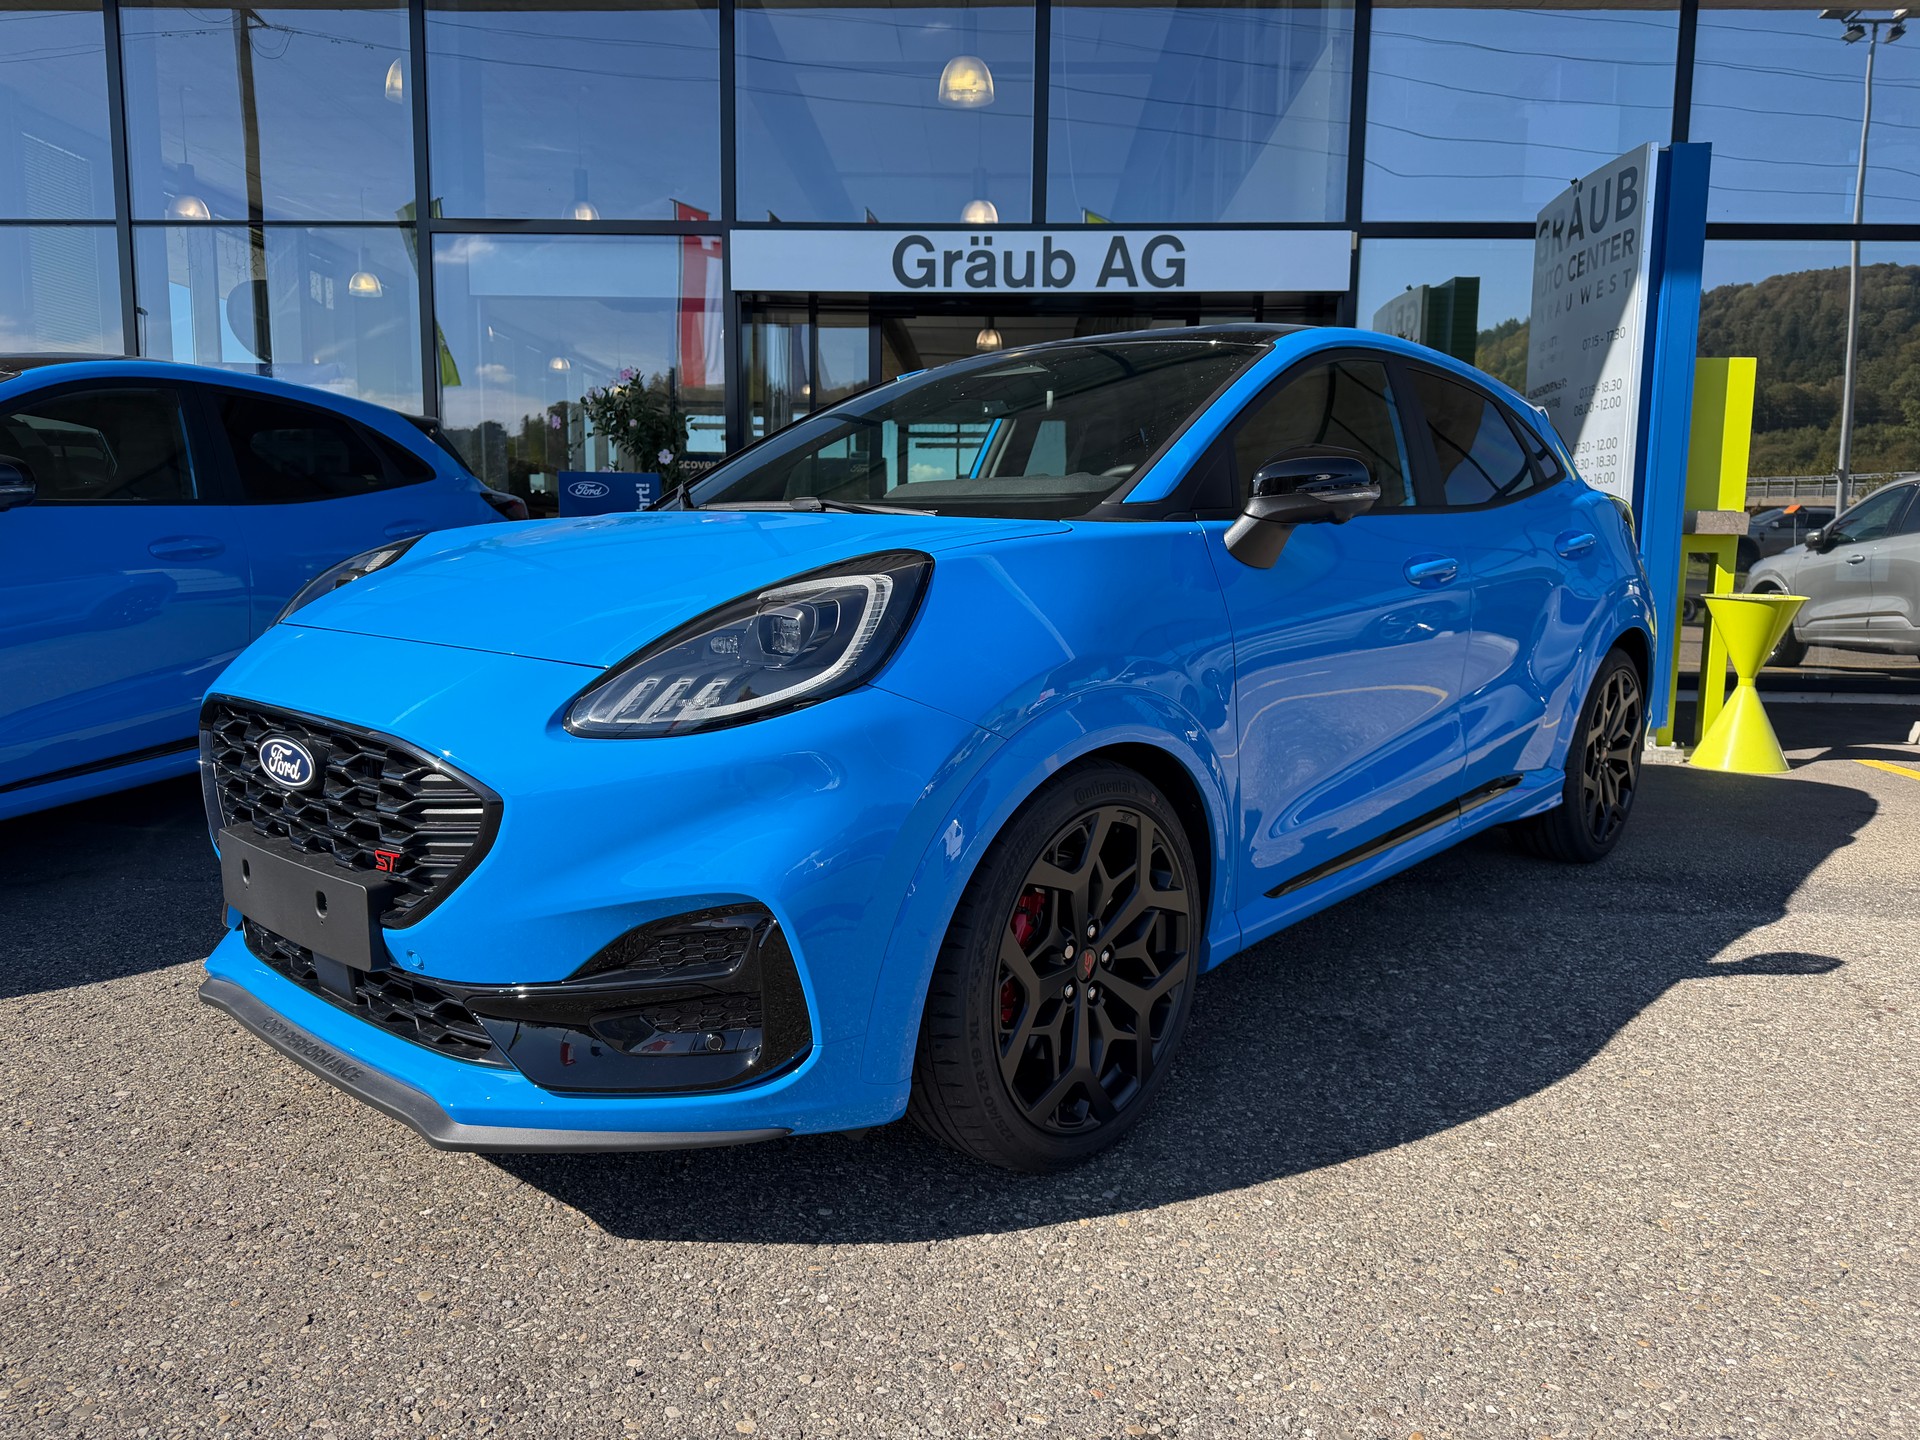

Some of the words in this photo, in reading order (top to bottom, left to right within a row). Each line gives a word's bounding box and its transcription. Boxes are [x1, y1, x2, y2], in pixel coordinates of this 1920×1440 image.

[1538, 166, 1638, 265] GRÄUB
[892, 234, 1075, 288] Gräub
[1096, 234, 1187, 288] AG
[1567, 228, 1636, 282] CENTER
[1580, 268, 1632, 305] WEST
[1600, 395, 1621, 411] 12.00
[1597, 436, 1618, 451] 12.00
[1596, 454, 1617, 468] 18.30
[574, 483, 603, 496] Ford
[1594, 471, 1616, 485] 16.00
[269, 744, 302, 780] Ford
[1073, 780, 1130, 805] Continental
[374, 849, 401, 873] ST
[259, 1015, 288, 1037] FORD
[284, 1031, 366, 1081] PERFORMANCE
